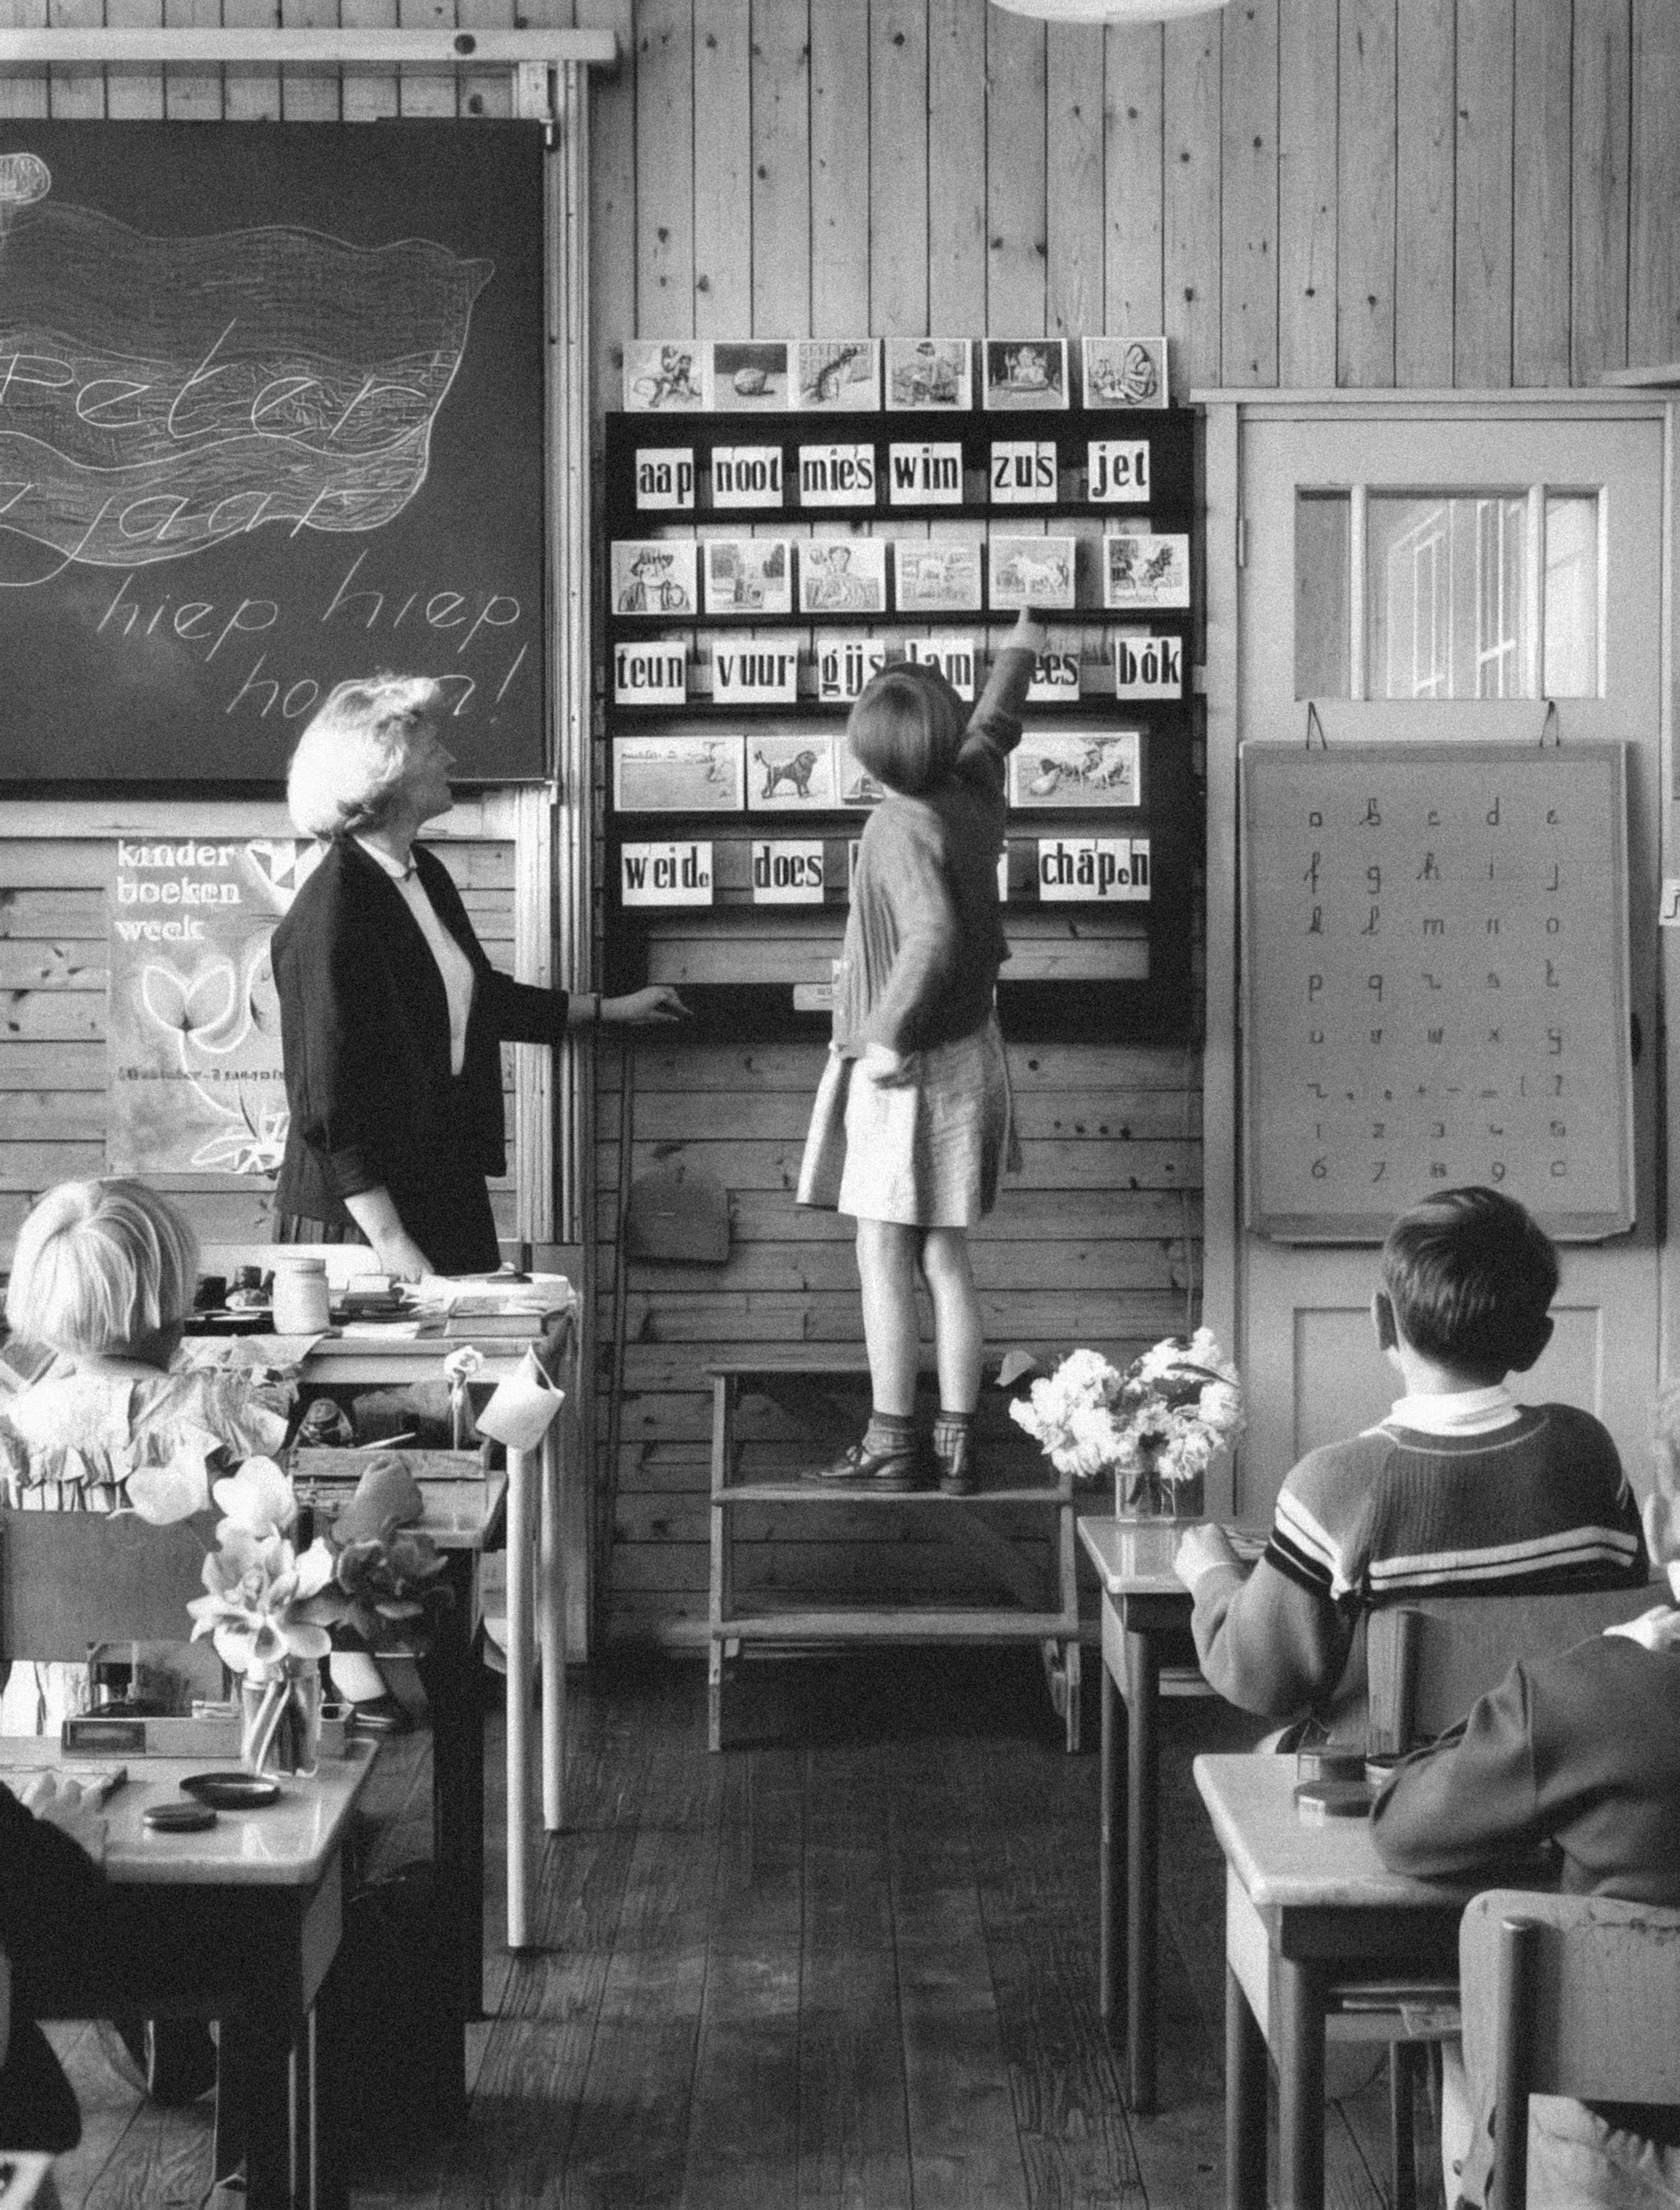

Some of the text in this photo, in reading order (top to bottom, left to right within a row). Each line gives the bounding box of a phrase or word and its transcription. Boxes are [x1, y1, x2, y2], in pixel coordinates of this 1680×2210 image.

[639, 444, 1147, 504] aap noot mies wim zus jet
[97, 549, 520, 661] hiep hiep
[617, 651, 683, 689] teun
[717, 655, 794, 687] vuur
[1308, 796, 1560, 829] a b c d e
[117, 840, 235, 867] kinder
[625, 846, 710, 889] weide
[754, 846, 823, 888] does
[1303, 851, 1321, 895] f
[1365, 865, 1382, 896] g
[116, 876, 243, 905] boeken
[114, 914, 206, 941] week
[1360, 905, 1381, 936] l
[1423, 918, 1445, 935] m
[1486, 918, 1500, 935] n
[1545, 917, 1560, 934] o
[1308, 973, 1323, 1003] p
[1367, 973, 1384, 1002] q
[1545, 959, 1559, 988] t
[1309, 1031, 1325, 1045] u
[1488, 1028, 1500, 1043] x
[1547, 1028, 1563, 1056] y
[1372, 1123, 1385, 1139] 2
[1431, 1121, 1446, 1138] 3
[1311, 1157, 1328, 1182] 6
[1371, 1161, 1386, 1184] 7
[1491, 1162, 1507, 1184] 9
[1550, 1159, 1567, 1177] 0
